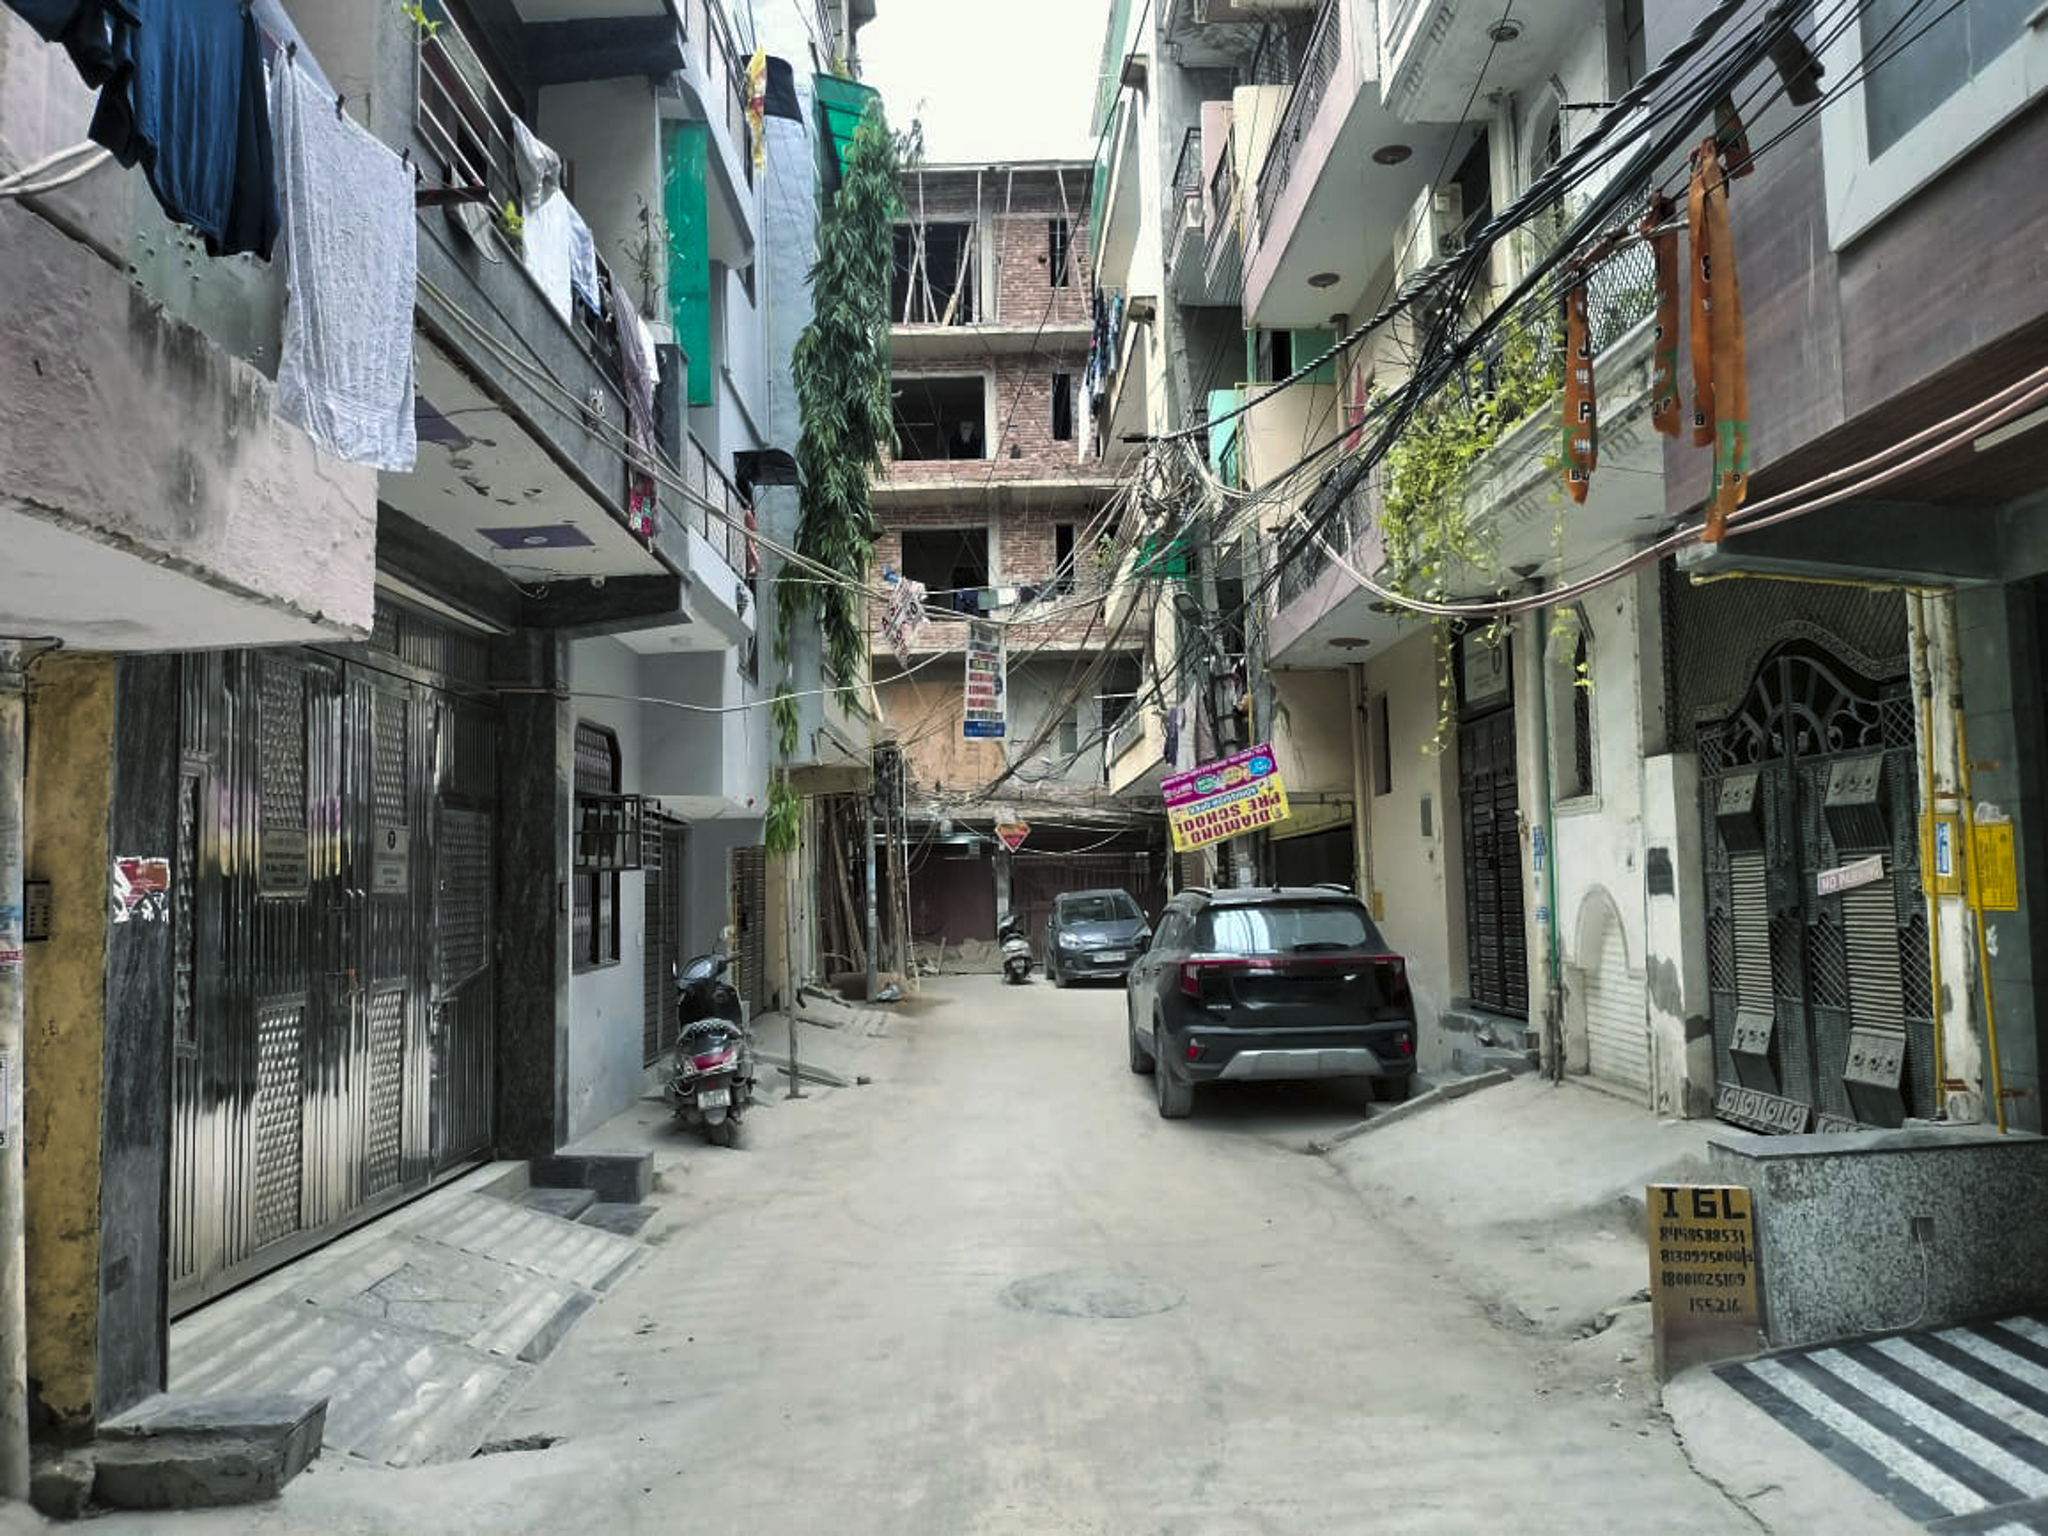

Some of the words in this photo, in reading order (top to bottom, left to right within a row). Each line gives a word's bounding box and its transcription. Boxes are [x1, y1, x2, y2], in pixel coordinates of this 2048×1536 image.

[1247, 793, 1281, 812] PRE
[1176, 803, 1242, 834] SCHOOL
[1190, 810, 1271, 844] DIAMOND
[1660, 1188, 1746, 1219] IGL
